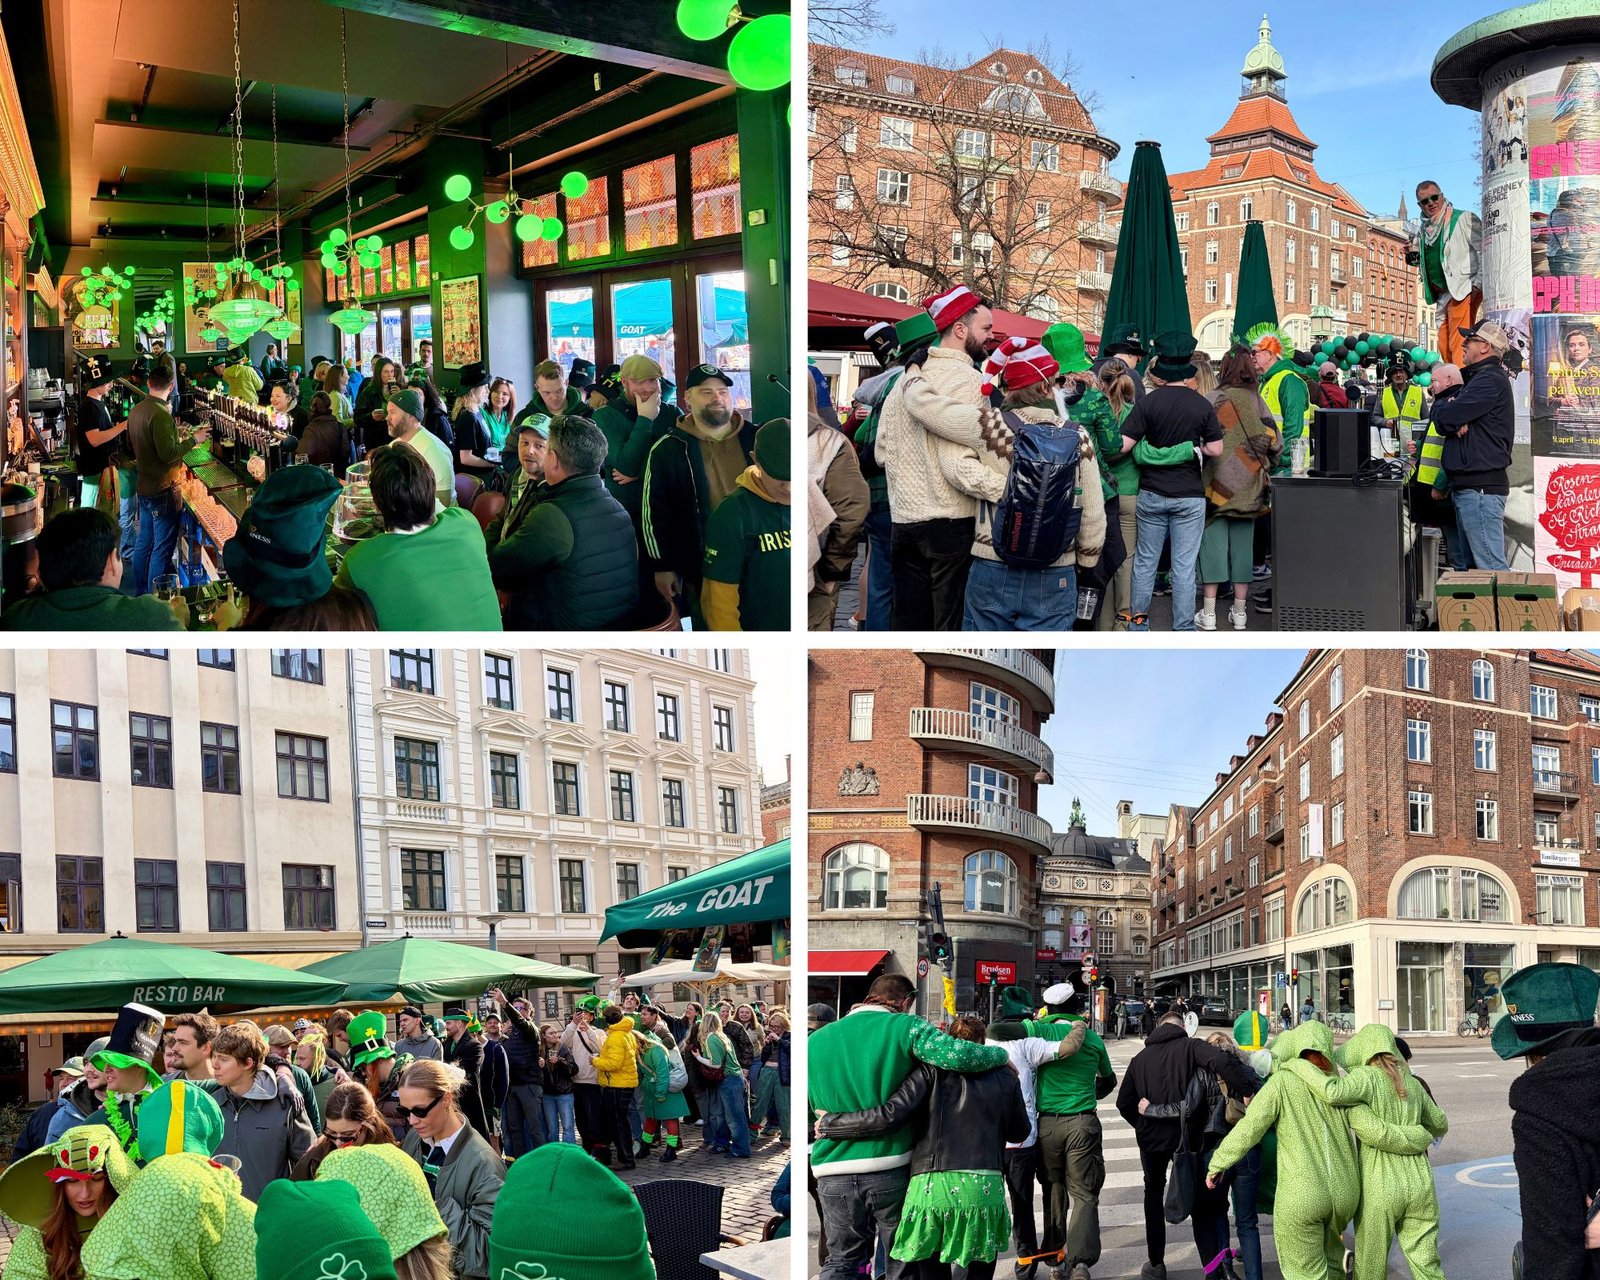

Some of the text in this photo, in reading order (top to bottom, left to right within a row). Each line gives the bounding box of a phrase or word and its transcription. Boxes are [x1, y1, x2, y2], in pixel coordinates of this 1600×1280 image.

[620, 325, 648, 335] GOAT
[1547, 366, 1588, 378] Annas
[642, 875, 774, 919] The GOAT
[919, 963, 927, 972] 40
[133, 985, 226, 1002] RESTO BAR
